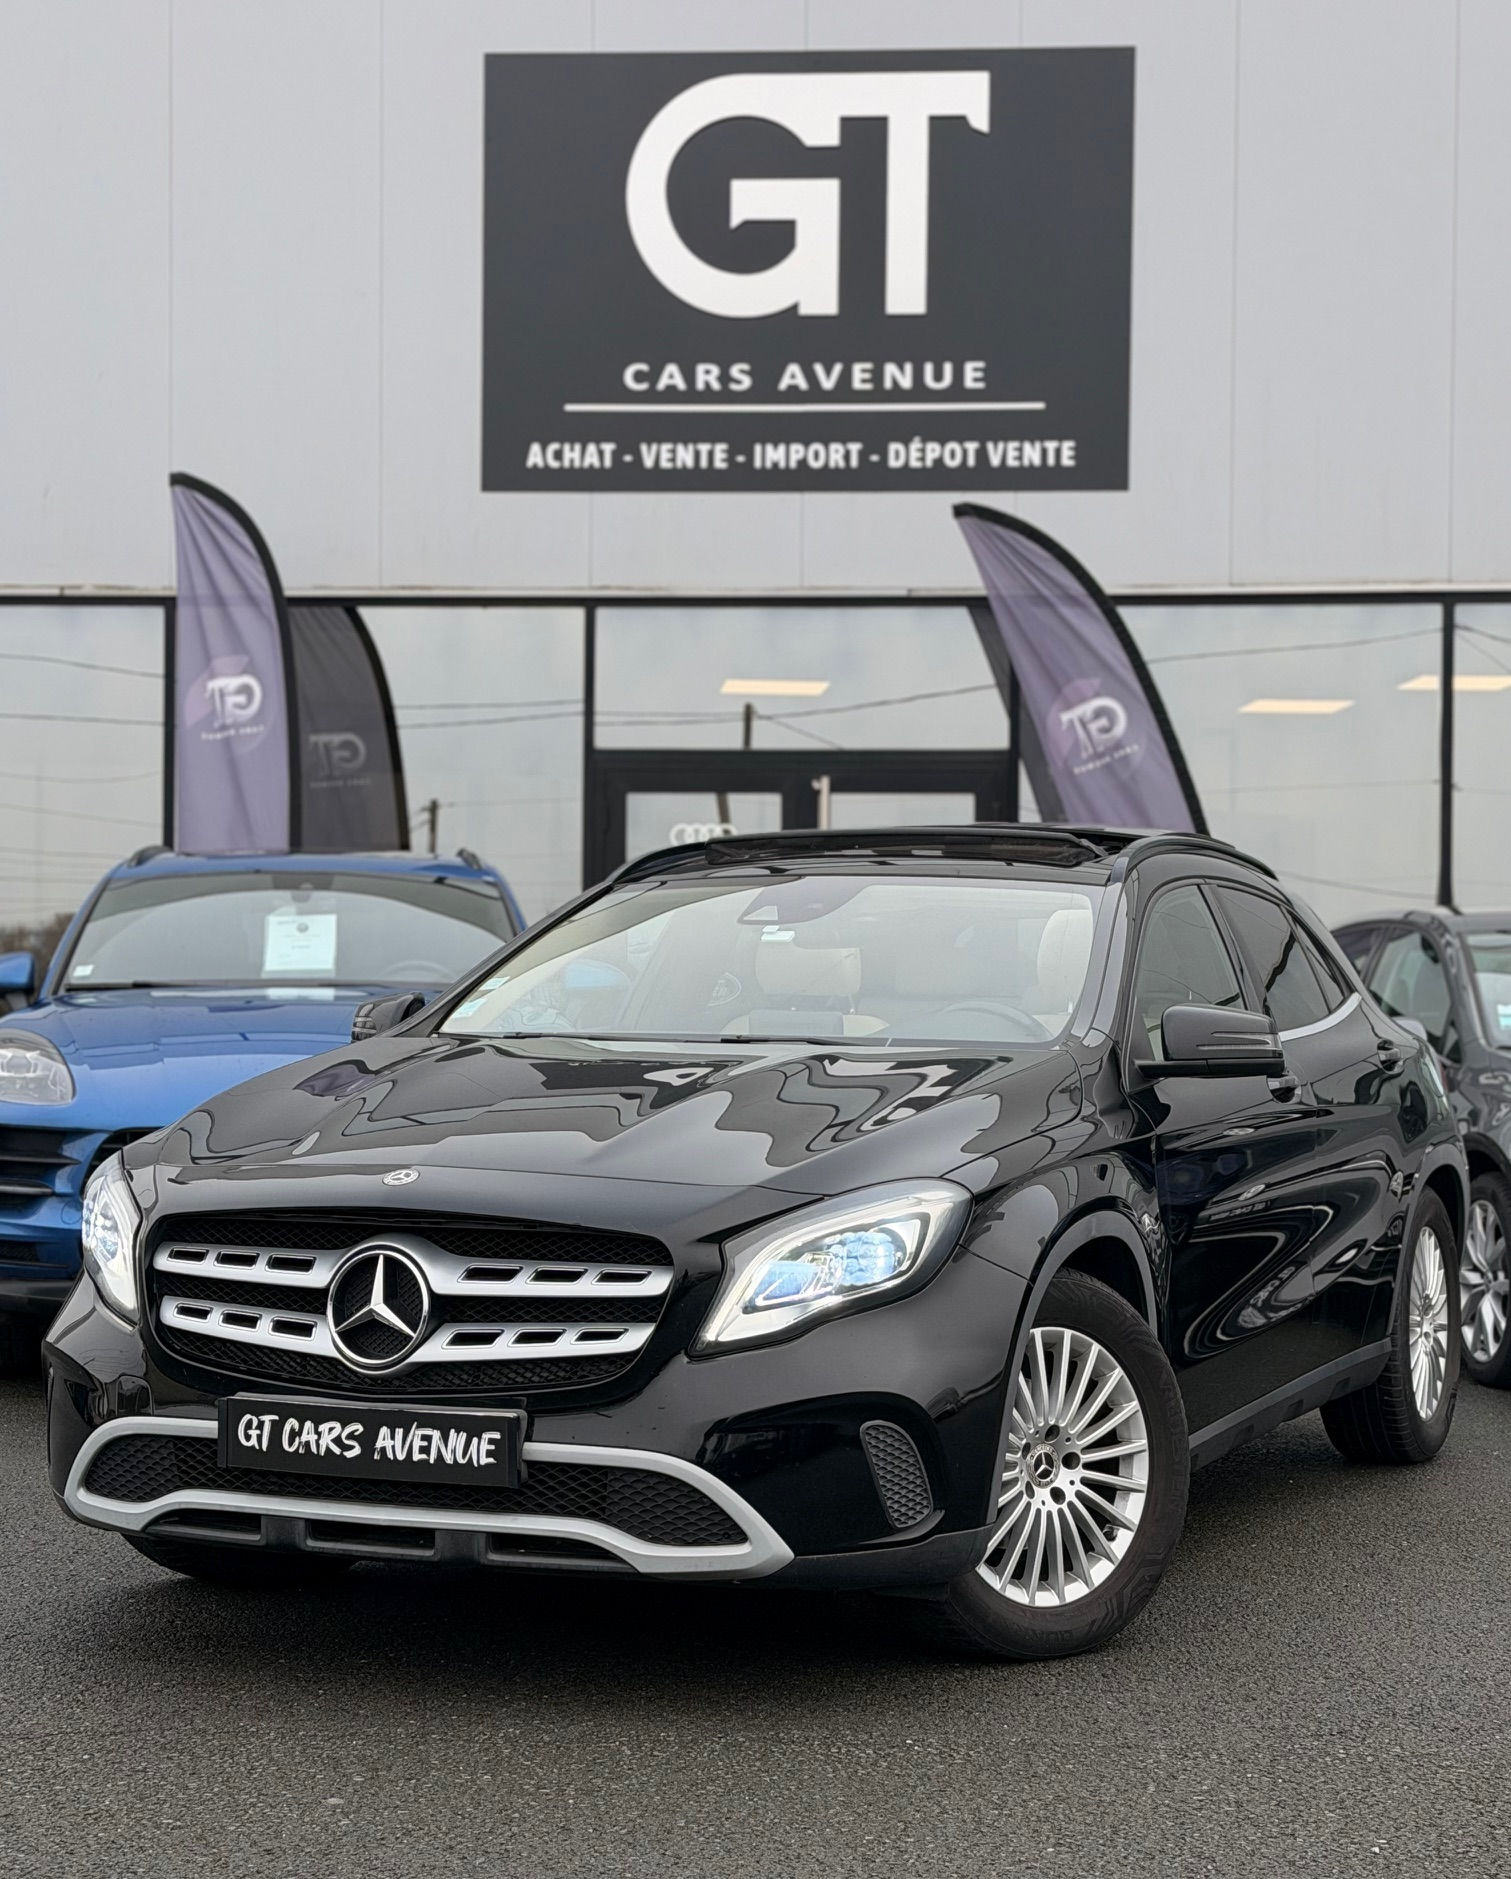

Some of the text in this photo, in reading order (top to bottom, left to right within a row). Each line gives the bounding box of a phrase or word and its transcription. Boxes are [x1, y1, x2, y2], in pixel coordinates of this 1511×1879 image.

[625, 70, 991, 318] GT
[623, 360, 986, 392] CARS AVENUE
[525, 441, 617, 469] ACHAT
[639, 442, 729, 470] VENTE
[753, 441, 863, 469] IMPORT
[887, 436, 980, 469] DÉPOT
[986, 440, 1076, 468] VENTE
[237, 1413, 501, 1467] GT CARS AVENUE
